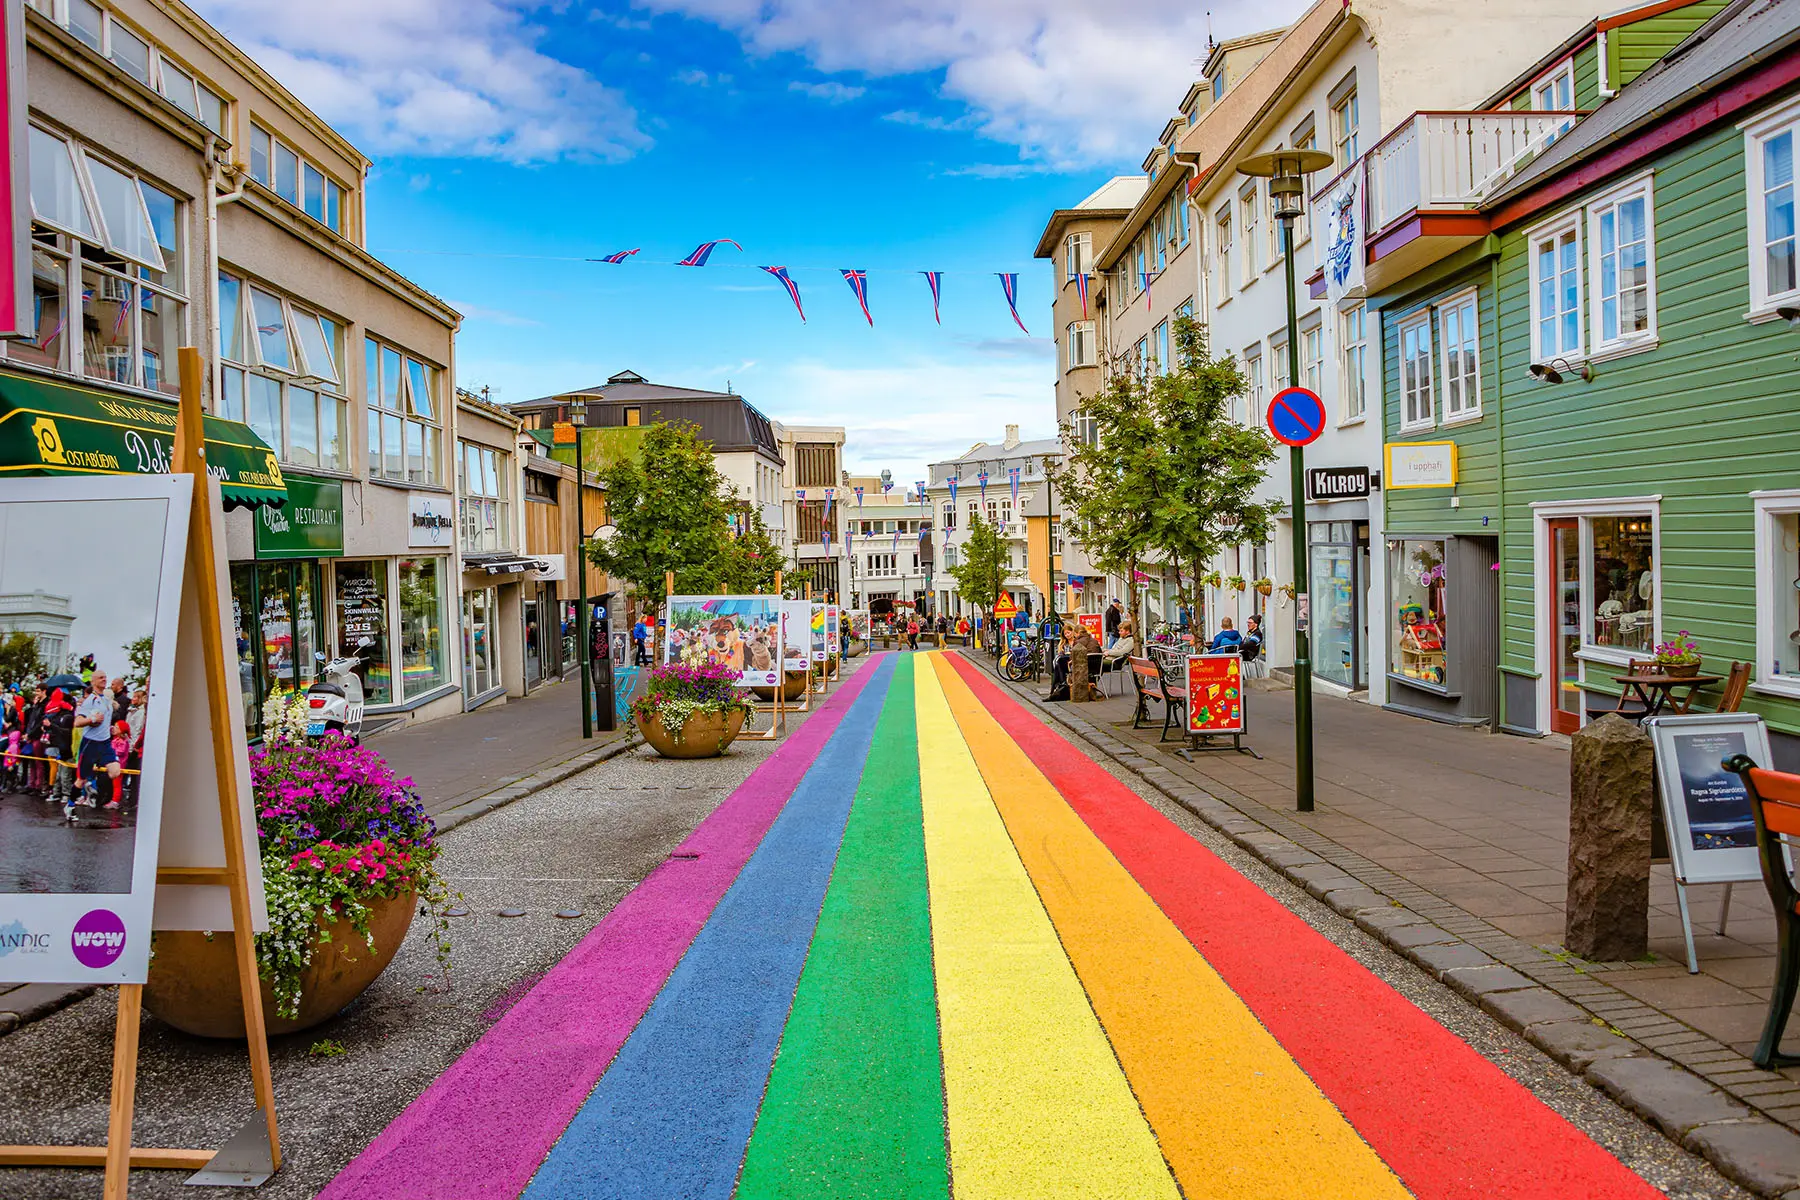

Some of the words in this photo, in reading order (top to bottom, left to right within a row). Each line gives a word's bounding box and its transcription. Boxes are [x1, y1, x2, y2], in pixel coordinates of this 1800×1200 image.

[294, 507, 337, 525] RESTAURANT
[73, 931, 125, 947] WOW
[106, 947, 118, 956] air
